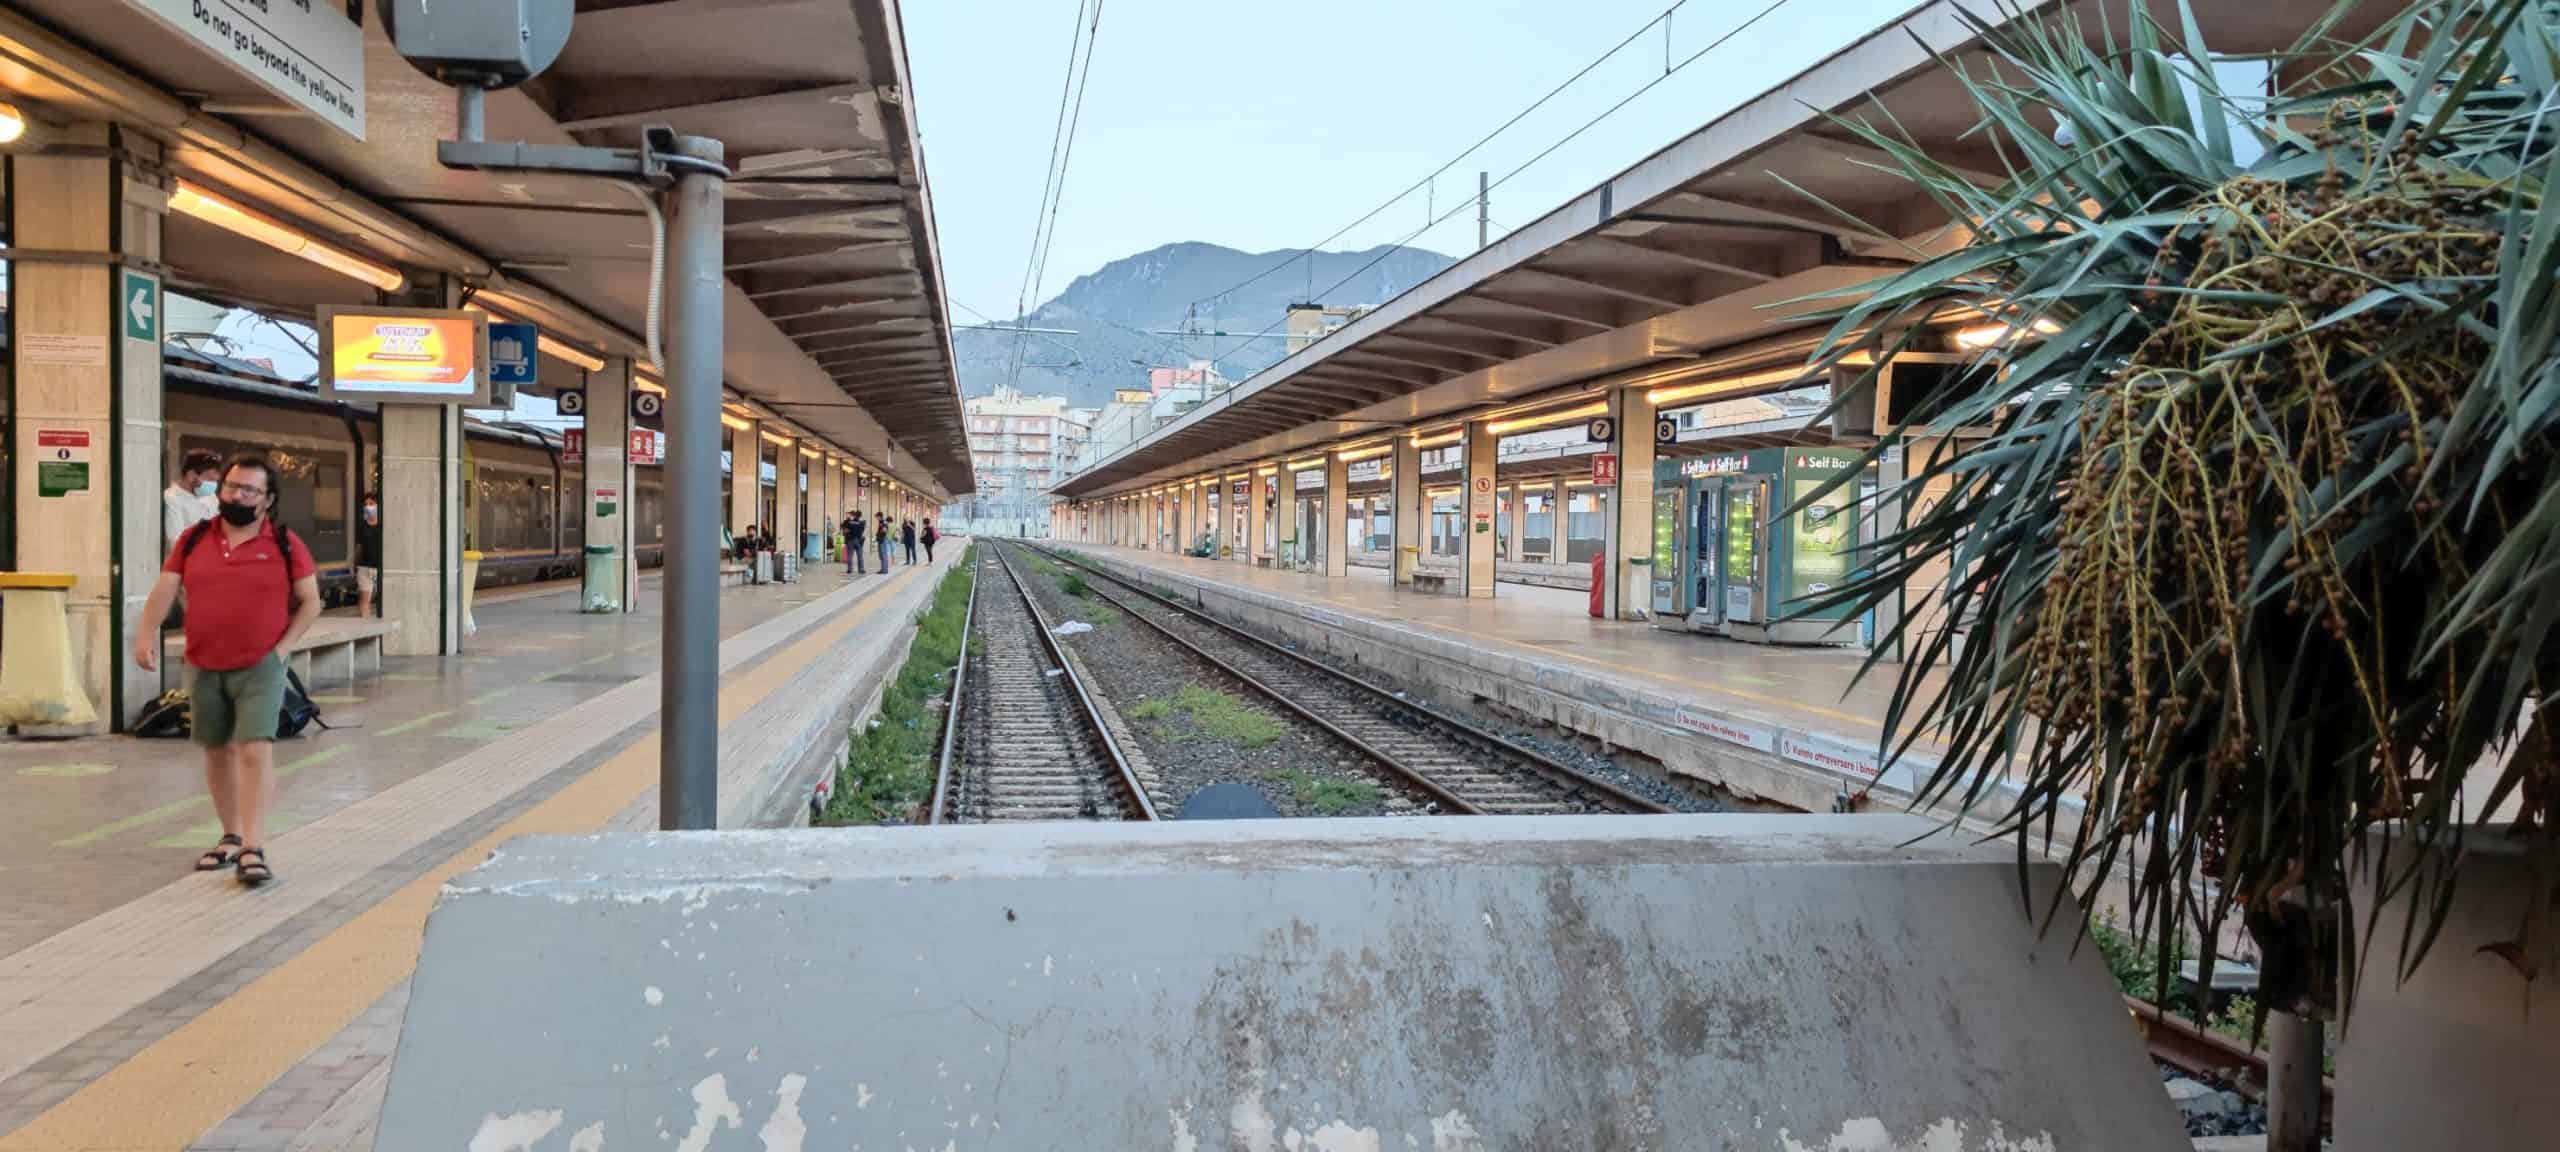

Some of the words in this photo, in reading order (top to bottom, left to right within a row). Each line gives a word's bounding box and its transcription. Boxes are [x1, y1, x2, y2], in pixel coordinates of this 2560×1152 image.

[193, 0, 209, 24] Do
[213, 15, 231, 39] not
[234, 29, 248, 50] go
[251, 35, 289, 75] beyond
[291, 63, 307, 88] the
[309, 79, 337, 105] yellow
[339, 92, 354, 119] line
[1808, 456, 1830, 468] Self
[1831, 456, 1851, 468] Bar
[1815, 752, 1855, 771] attraversare
